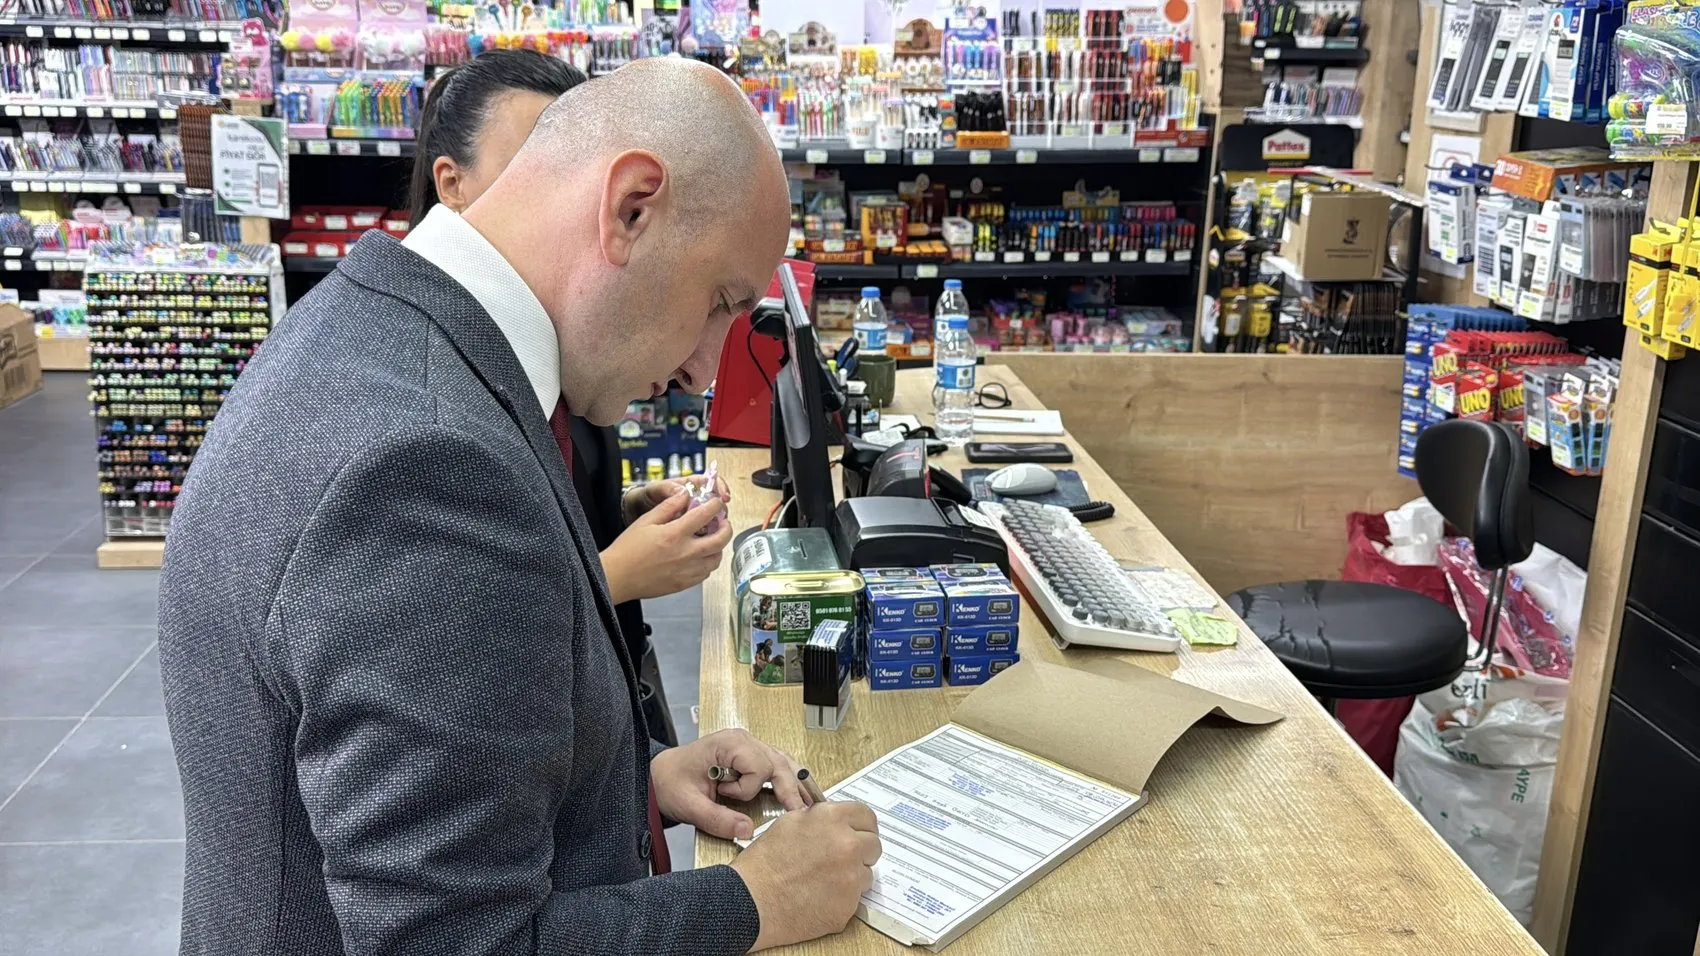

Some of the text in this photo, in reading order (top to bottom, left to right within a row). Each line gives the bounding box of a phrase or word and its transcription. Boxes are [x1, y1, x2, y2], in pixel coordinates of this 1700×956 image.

[1268, 140, 1305, 152] Pattex
[1432, 354, 1457, 377] UNO
[1460, 388, 1491, 414] UNO
[877, 606, 906, 616] KENKO
[952, 603, 980, 612] KENKO
[874, 639, 902, 648] KENKO
[951, 634, 979, 644] KENKO
[875, 668, 903, 677] KENKO
[954, 664, 982, 673] KENKO
